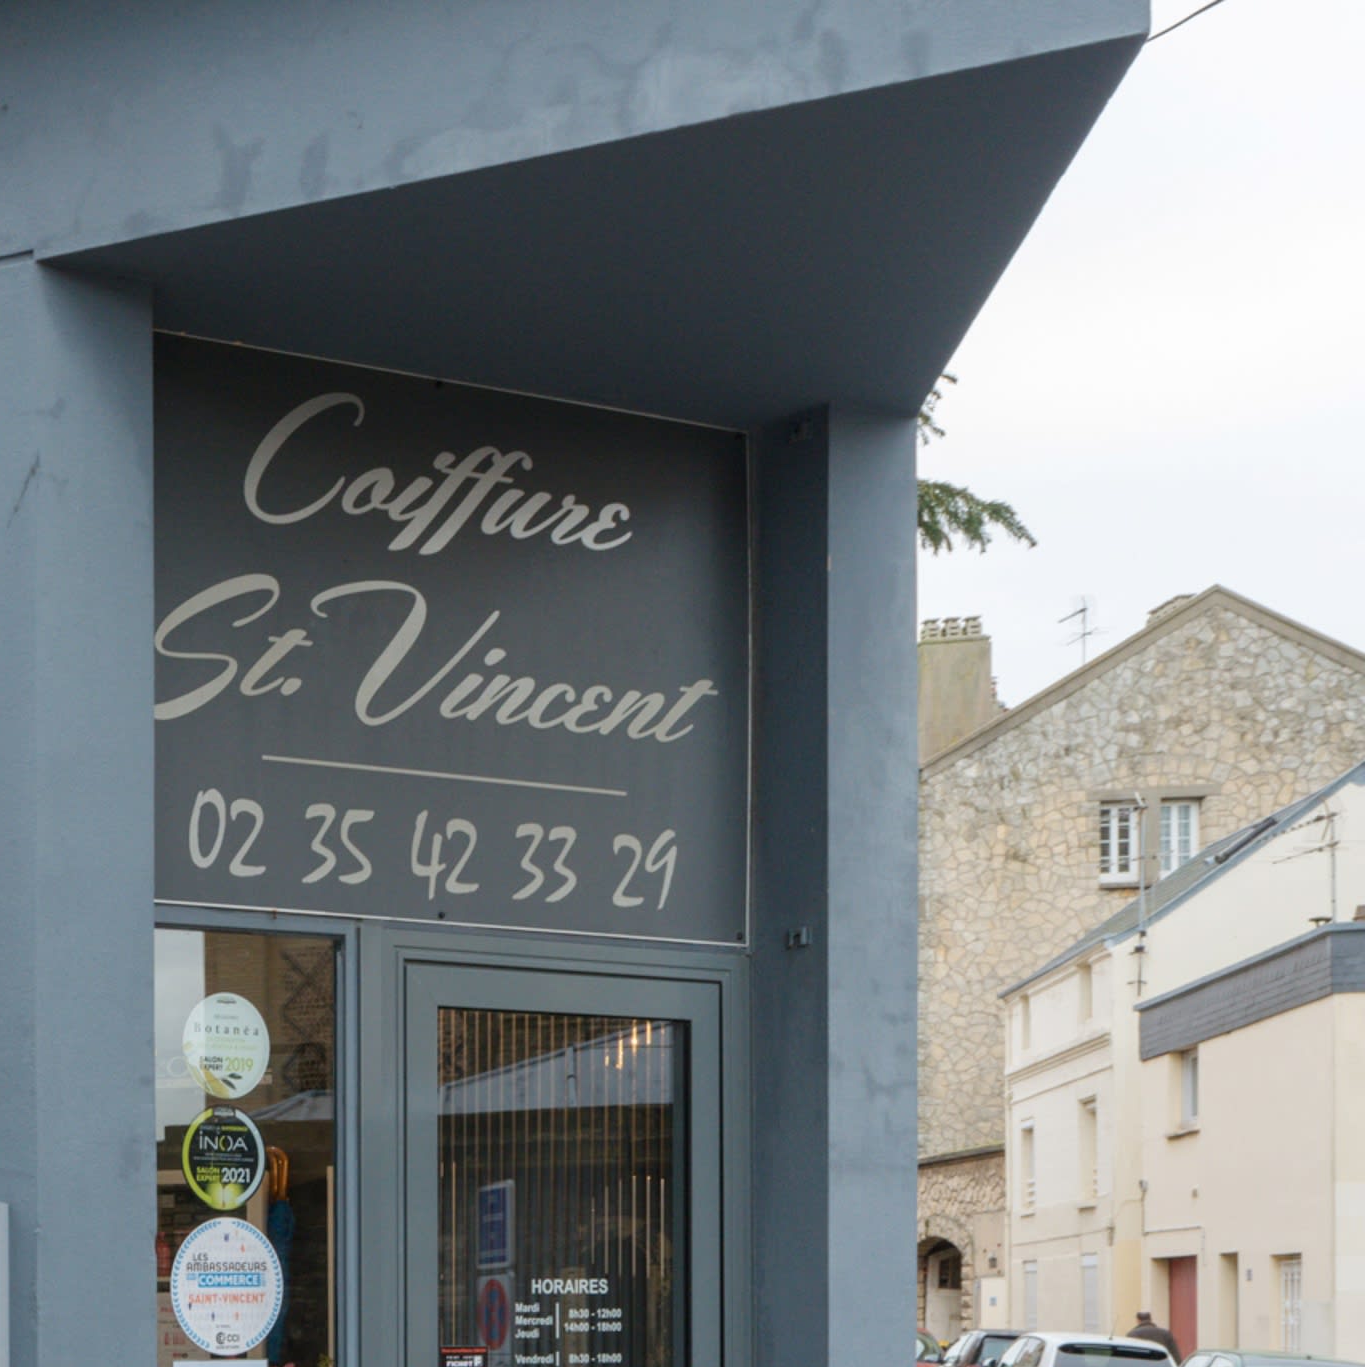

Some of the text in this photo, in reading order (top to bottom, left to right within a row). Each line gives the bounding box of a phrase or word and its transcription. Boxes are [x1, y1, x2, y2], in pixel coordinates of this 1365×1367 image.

[243, 391, 633, 555] Coiffure
[154, 574, 718, 743] St. Vincent
[188, 788, 678, 910] 02 35 42 33 29
[225, 1056, 254, 1072] 2019
[221, 1168, 250, 1183] 2021
[531, 1278, 609, 1295] HORAIRES
[188, 1293, 266, 1304] SAINT-VINCENT
[515, 1302, 540, 1313] Mardi
[515, 1315, 553, 1326] Mercredi
[515, 1353, 554, 1364] Vendredi
